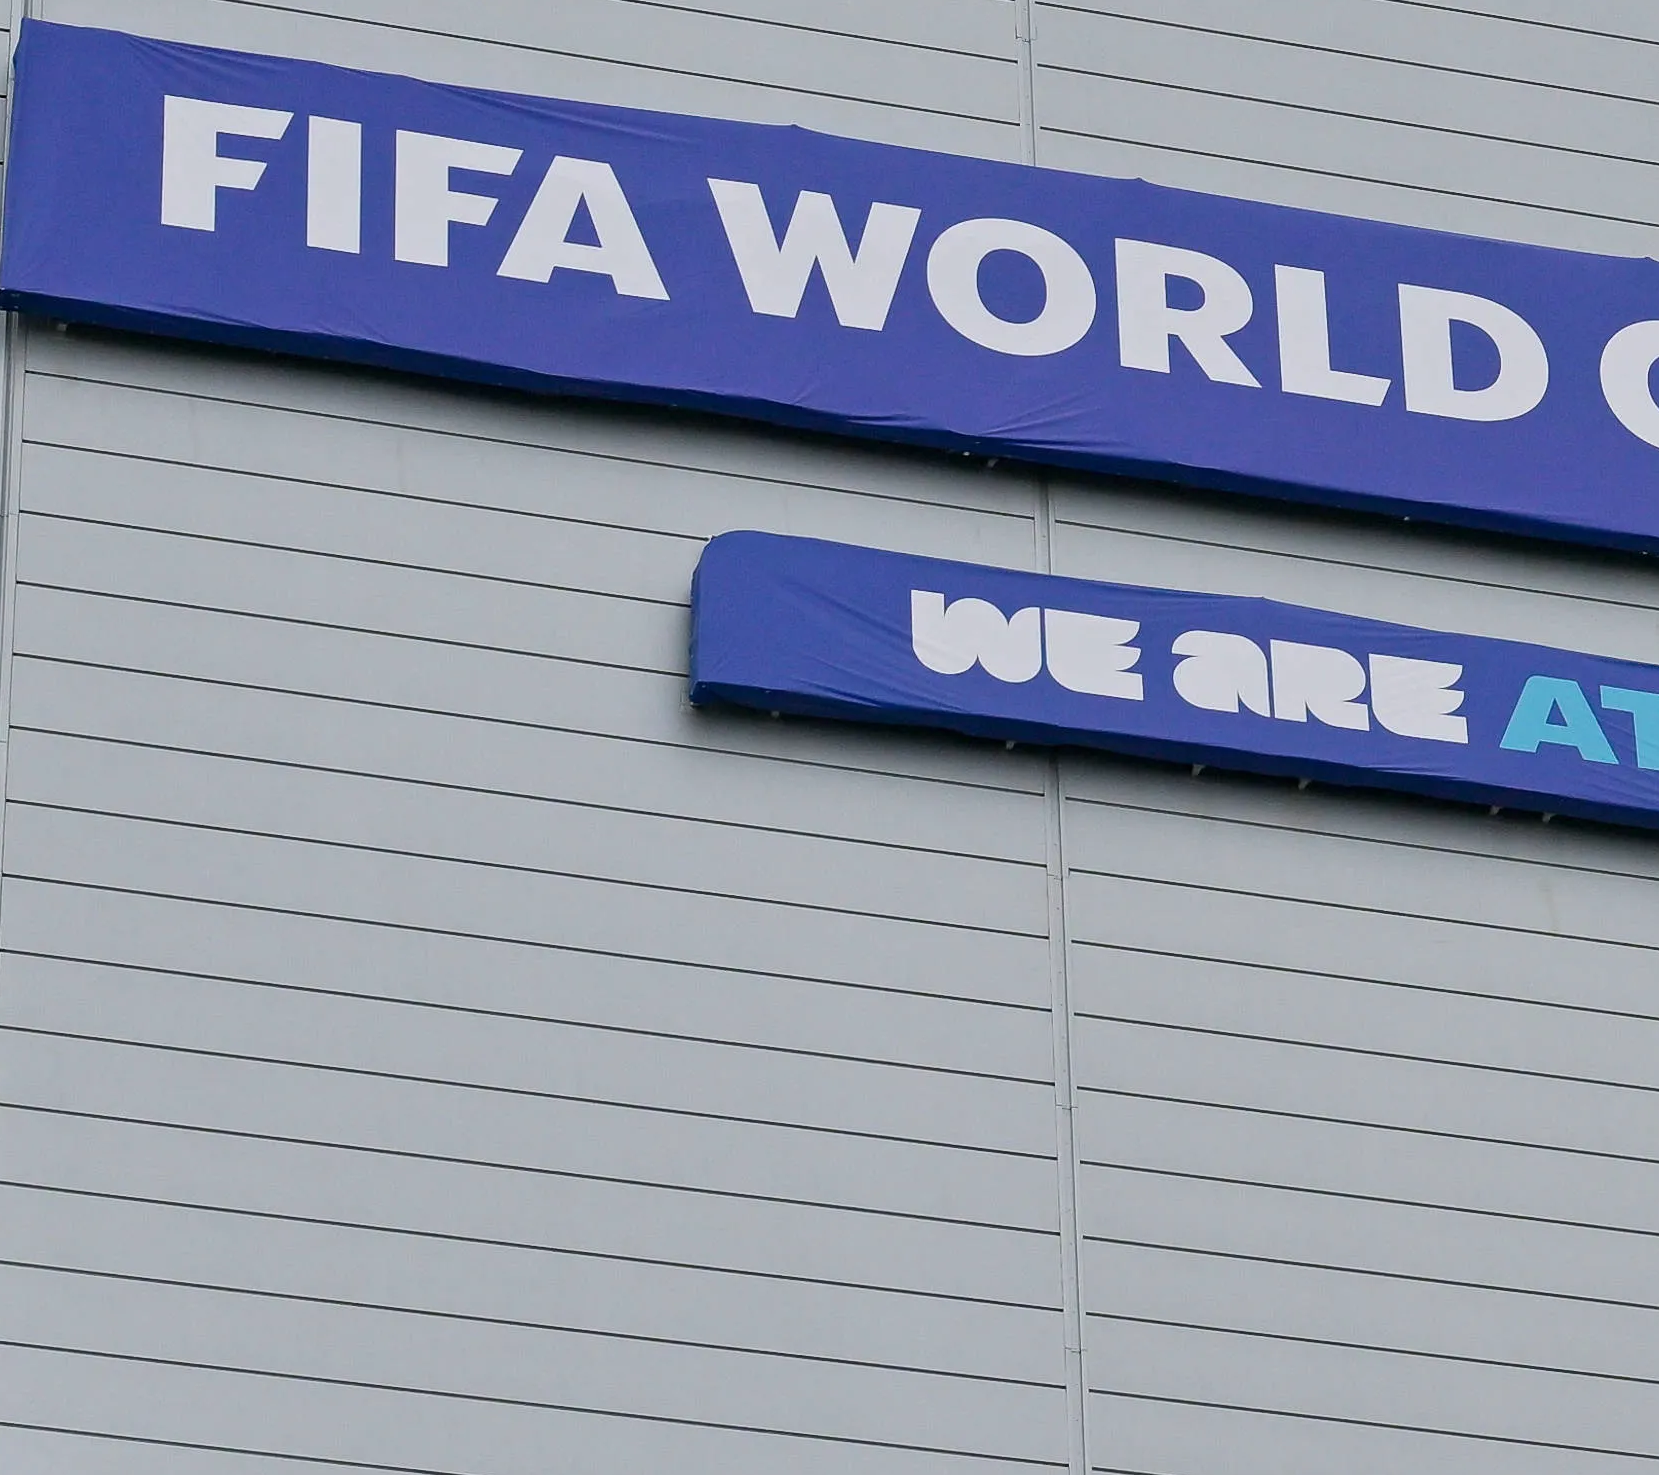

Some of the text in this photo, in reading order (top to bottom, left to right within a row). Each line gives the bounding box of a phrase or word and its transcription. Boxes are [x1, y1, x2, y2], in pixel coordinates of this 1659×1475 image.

[160, 94, 672, 302] FIFA
[706, 177, 1550, 423] WORLD
[910, 589, 1145, 702] WE
